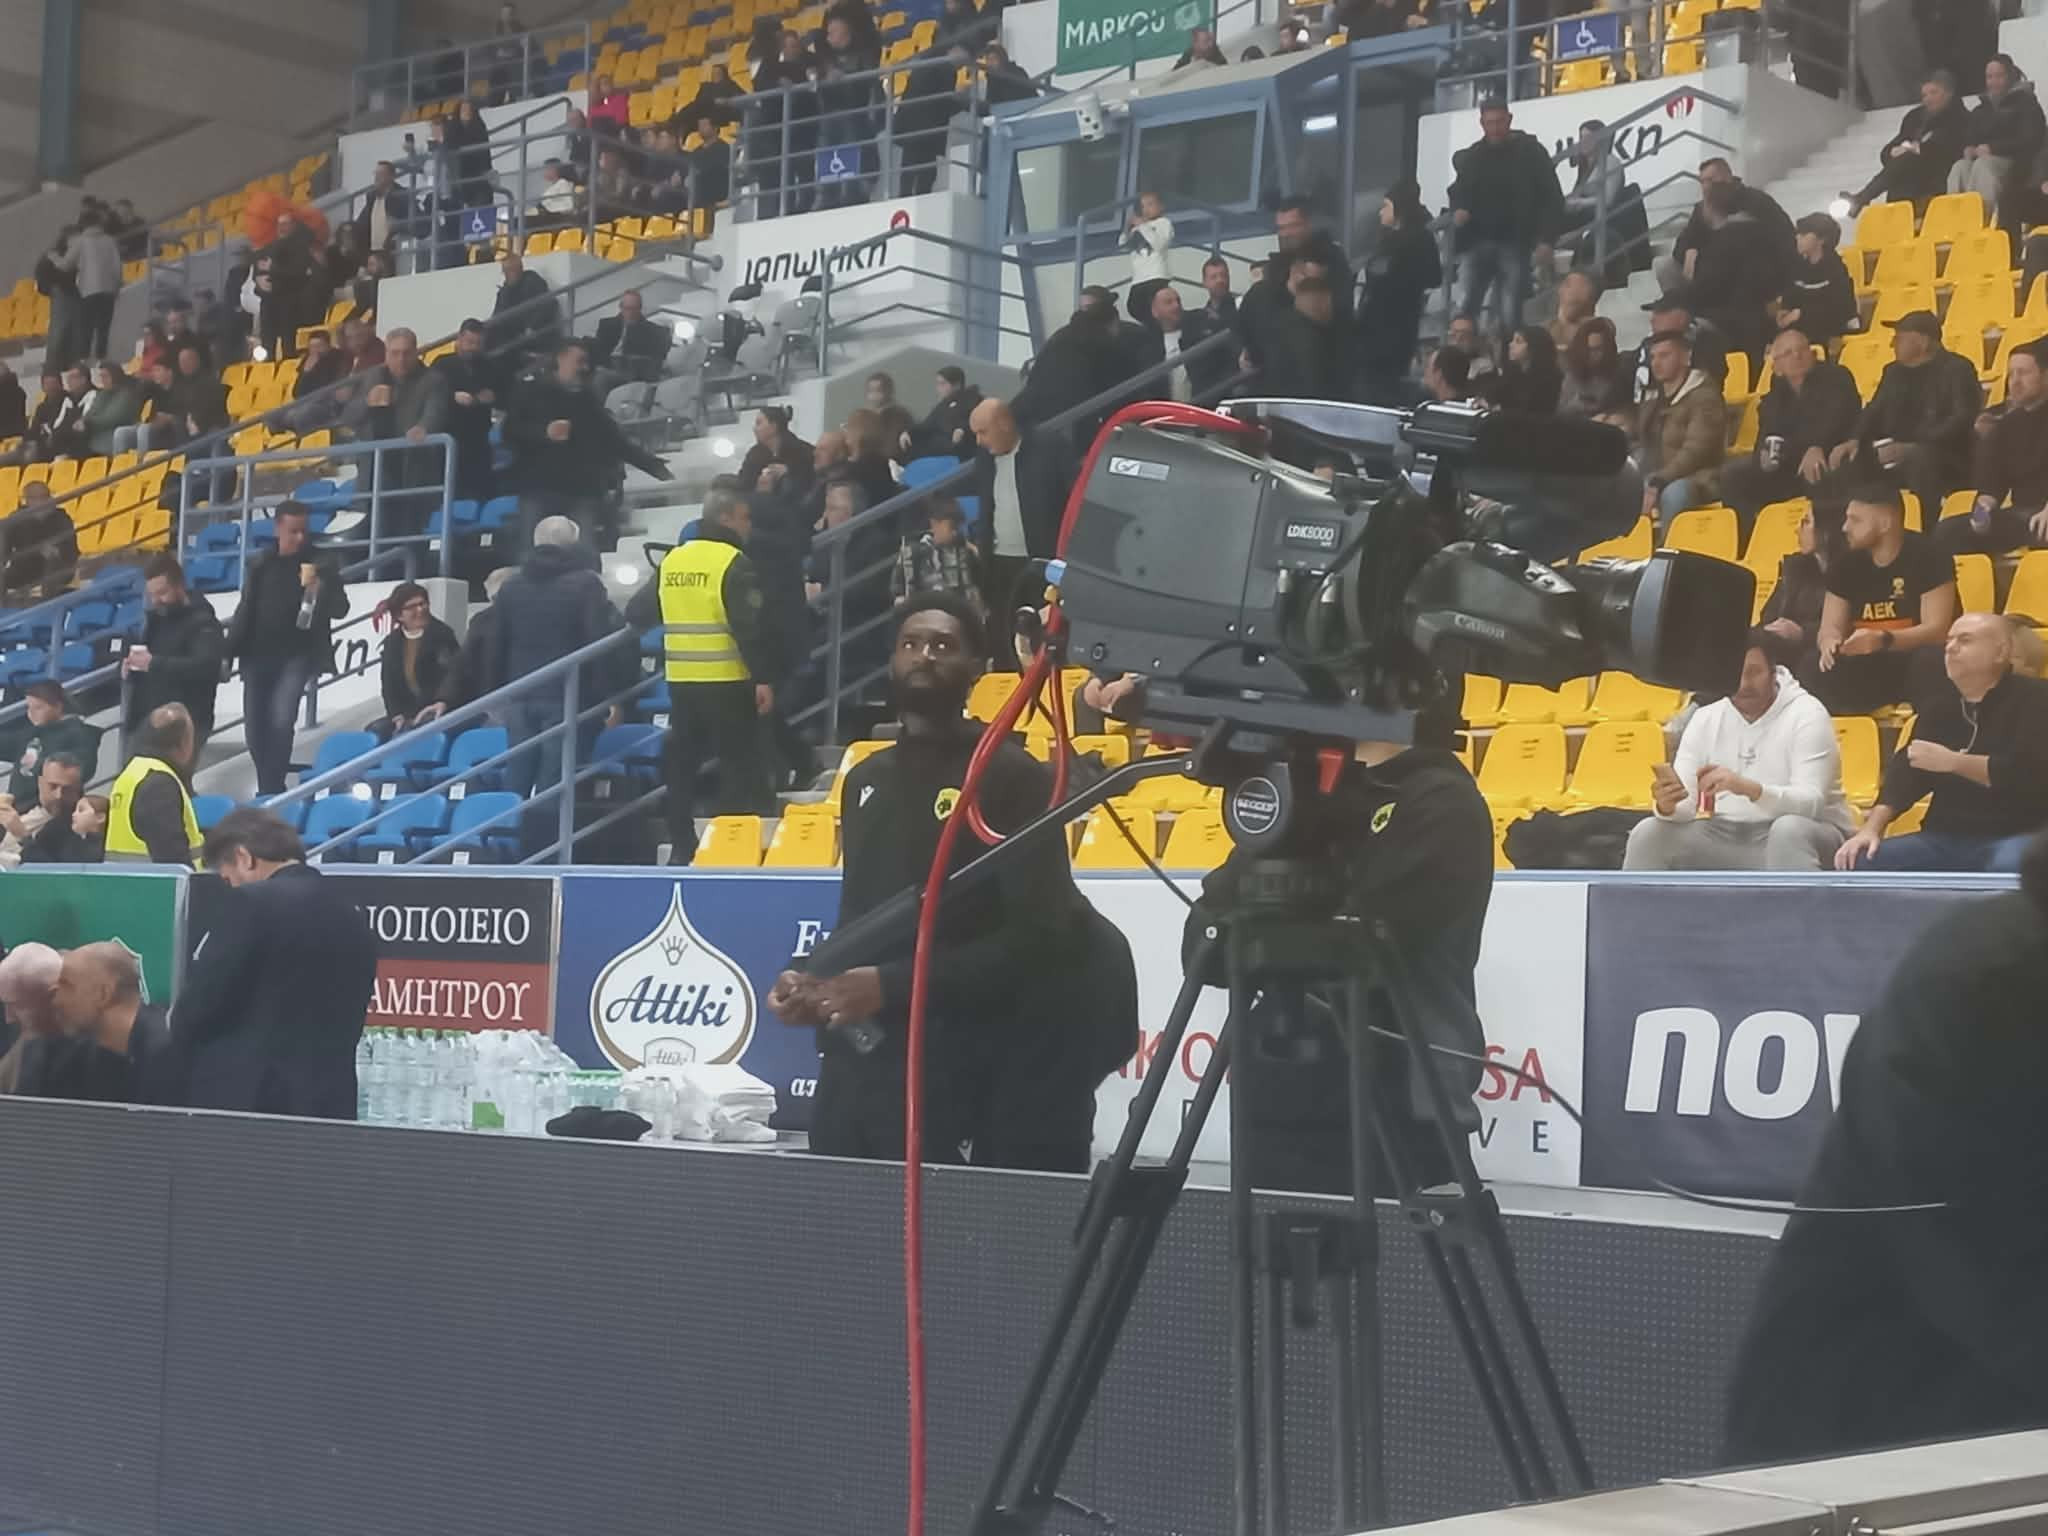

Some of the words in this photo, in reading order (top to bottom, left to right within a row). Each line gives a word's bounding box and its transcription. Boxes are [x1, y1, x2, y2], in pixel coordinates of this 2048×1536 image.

[1064, 9, 1166, 49] MARKOU
[664, 571, 711, 588] SECURITY
[1453, 612, 1506, 640] Canon
[365, 904, 531, 946] ΟΠΟΙΕΙΟ
[366, 976, 531, 1022] ΑΜΗΤΡΟΥ
[604, 974, 734, 1028] Attiki
